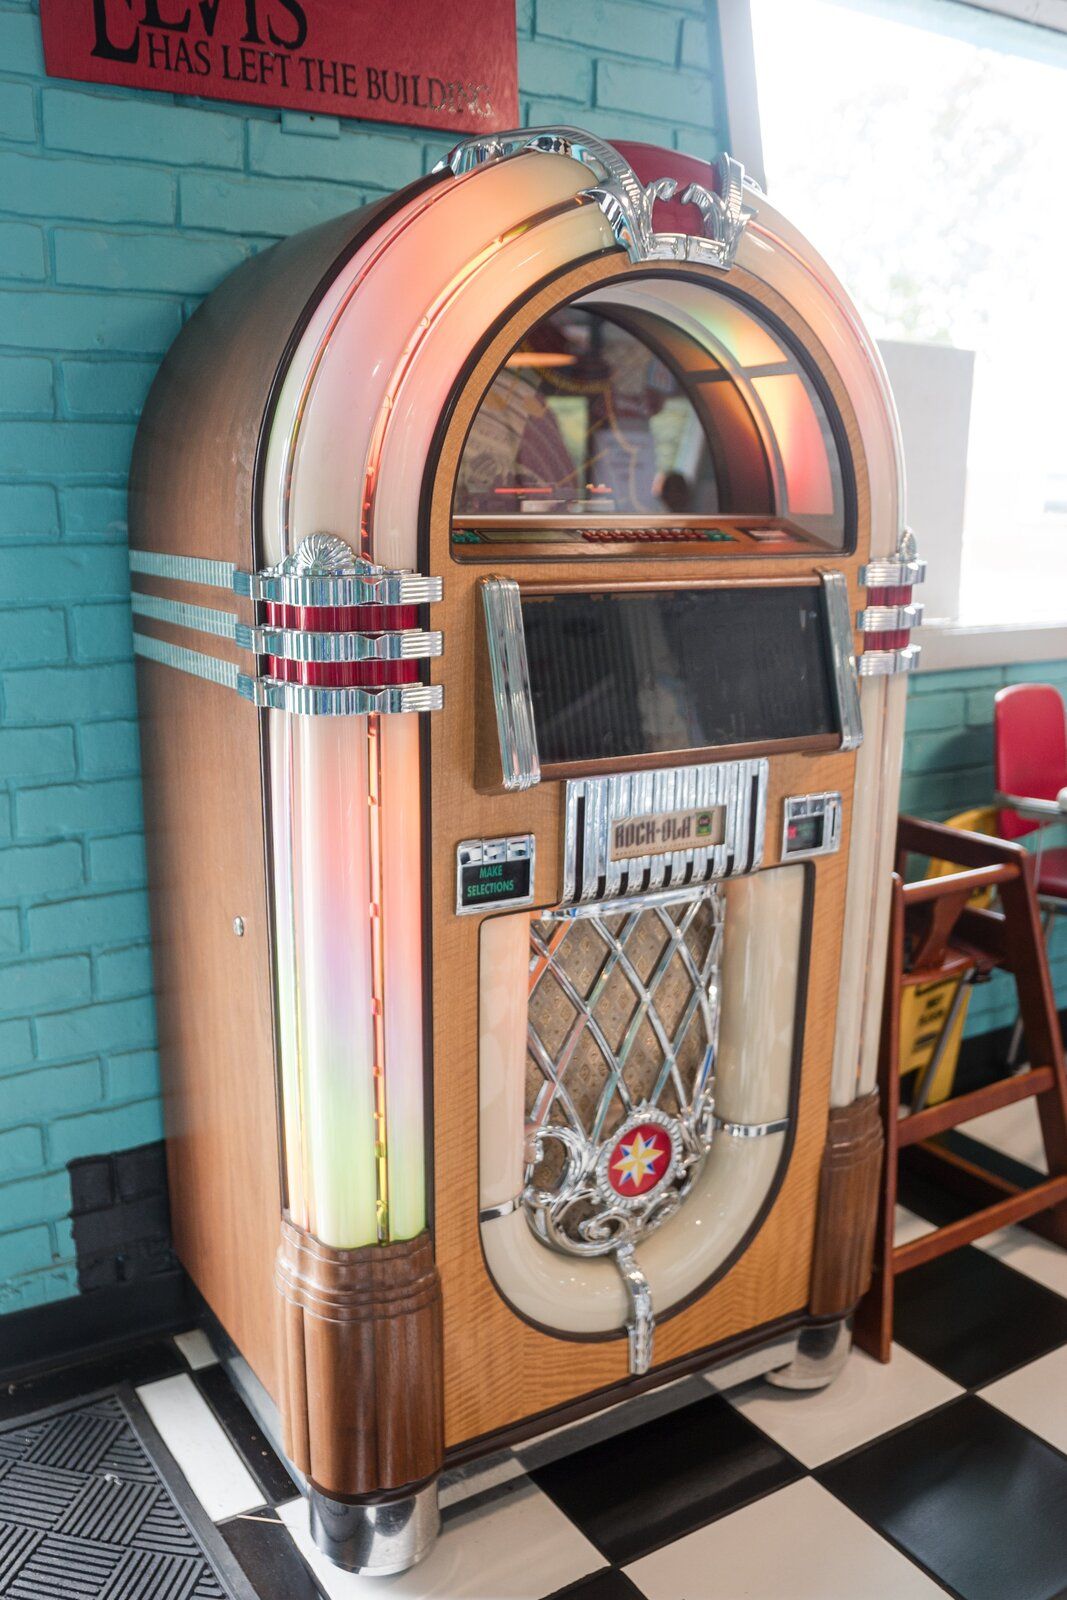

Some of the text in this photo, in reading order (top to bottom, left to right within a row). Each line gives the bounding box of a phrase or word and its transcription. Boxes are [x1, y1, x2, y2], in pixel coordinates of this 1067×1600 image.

[147, 32, 211, 76] HAS
[222, 44, 291, 87] LEFT
[299, 57, 358, 97] THE
[615, 815, 691, 849] ROCK-OLA
[479, 865, 503, 879] MAKE
[467, 880, 514, 897] SELECTIONS
